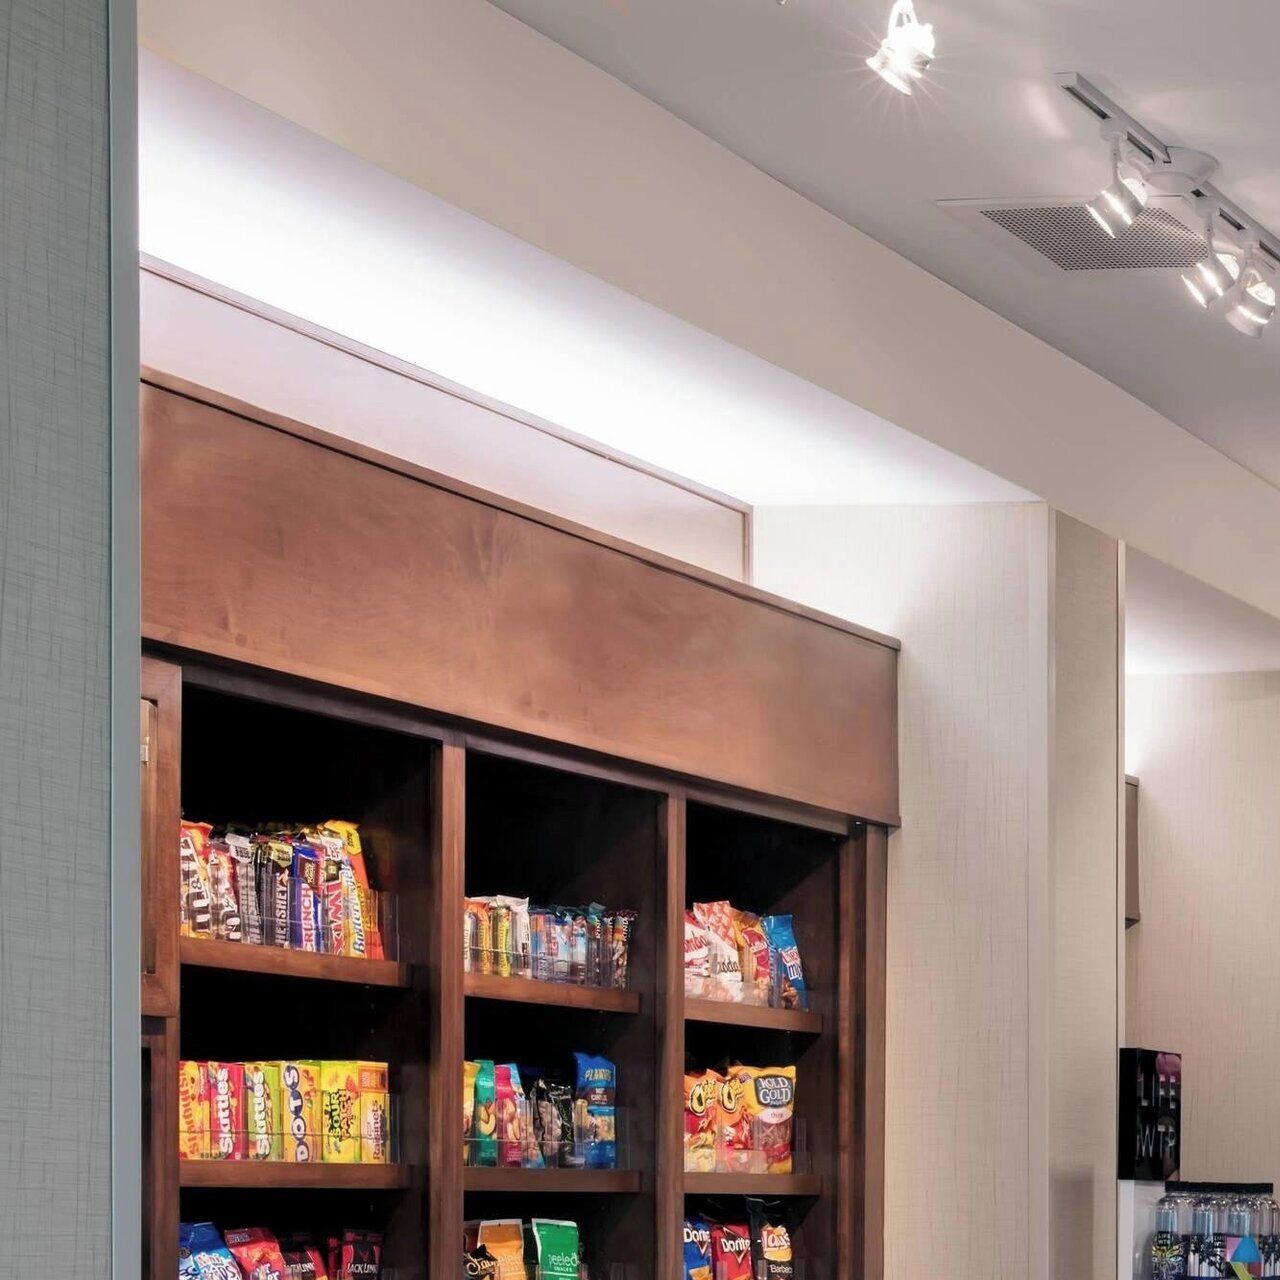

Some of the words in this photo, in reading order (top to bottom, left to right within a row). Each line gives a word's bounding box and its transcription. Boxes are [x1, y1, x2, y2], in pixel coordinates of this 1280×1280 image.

[275, 869, 289, 946] HERSHEY'S
[302, 883, 316, 952] CRUNCH
[217, 1068, 234, 1157] Skittles
[254, 1070, 271, 1157] Skittles
[284, 1065, 310, 1162] DOTS
[330, 1091, 341, 1137] SOUR
[340, 1089, 350, 1141] PATCH
[759, 1088, 791, 1104] GOLD
[1141, 1072, 1176, 1109] LIFE
